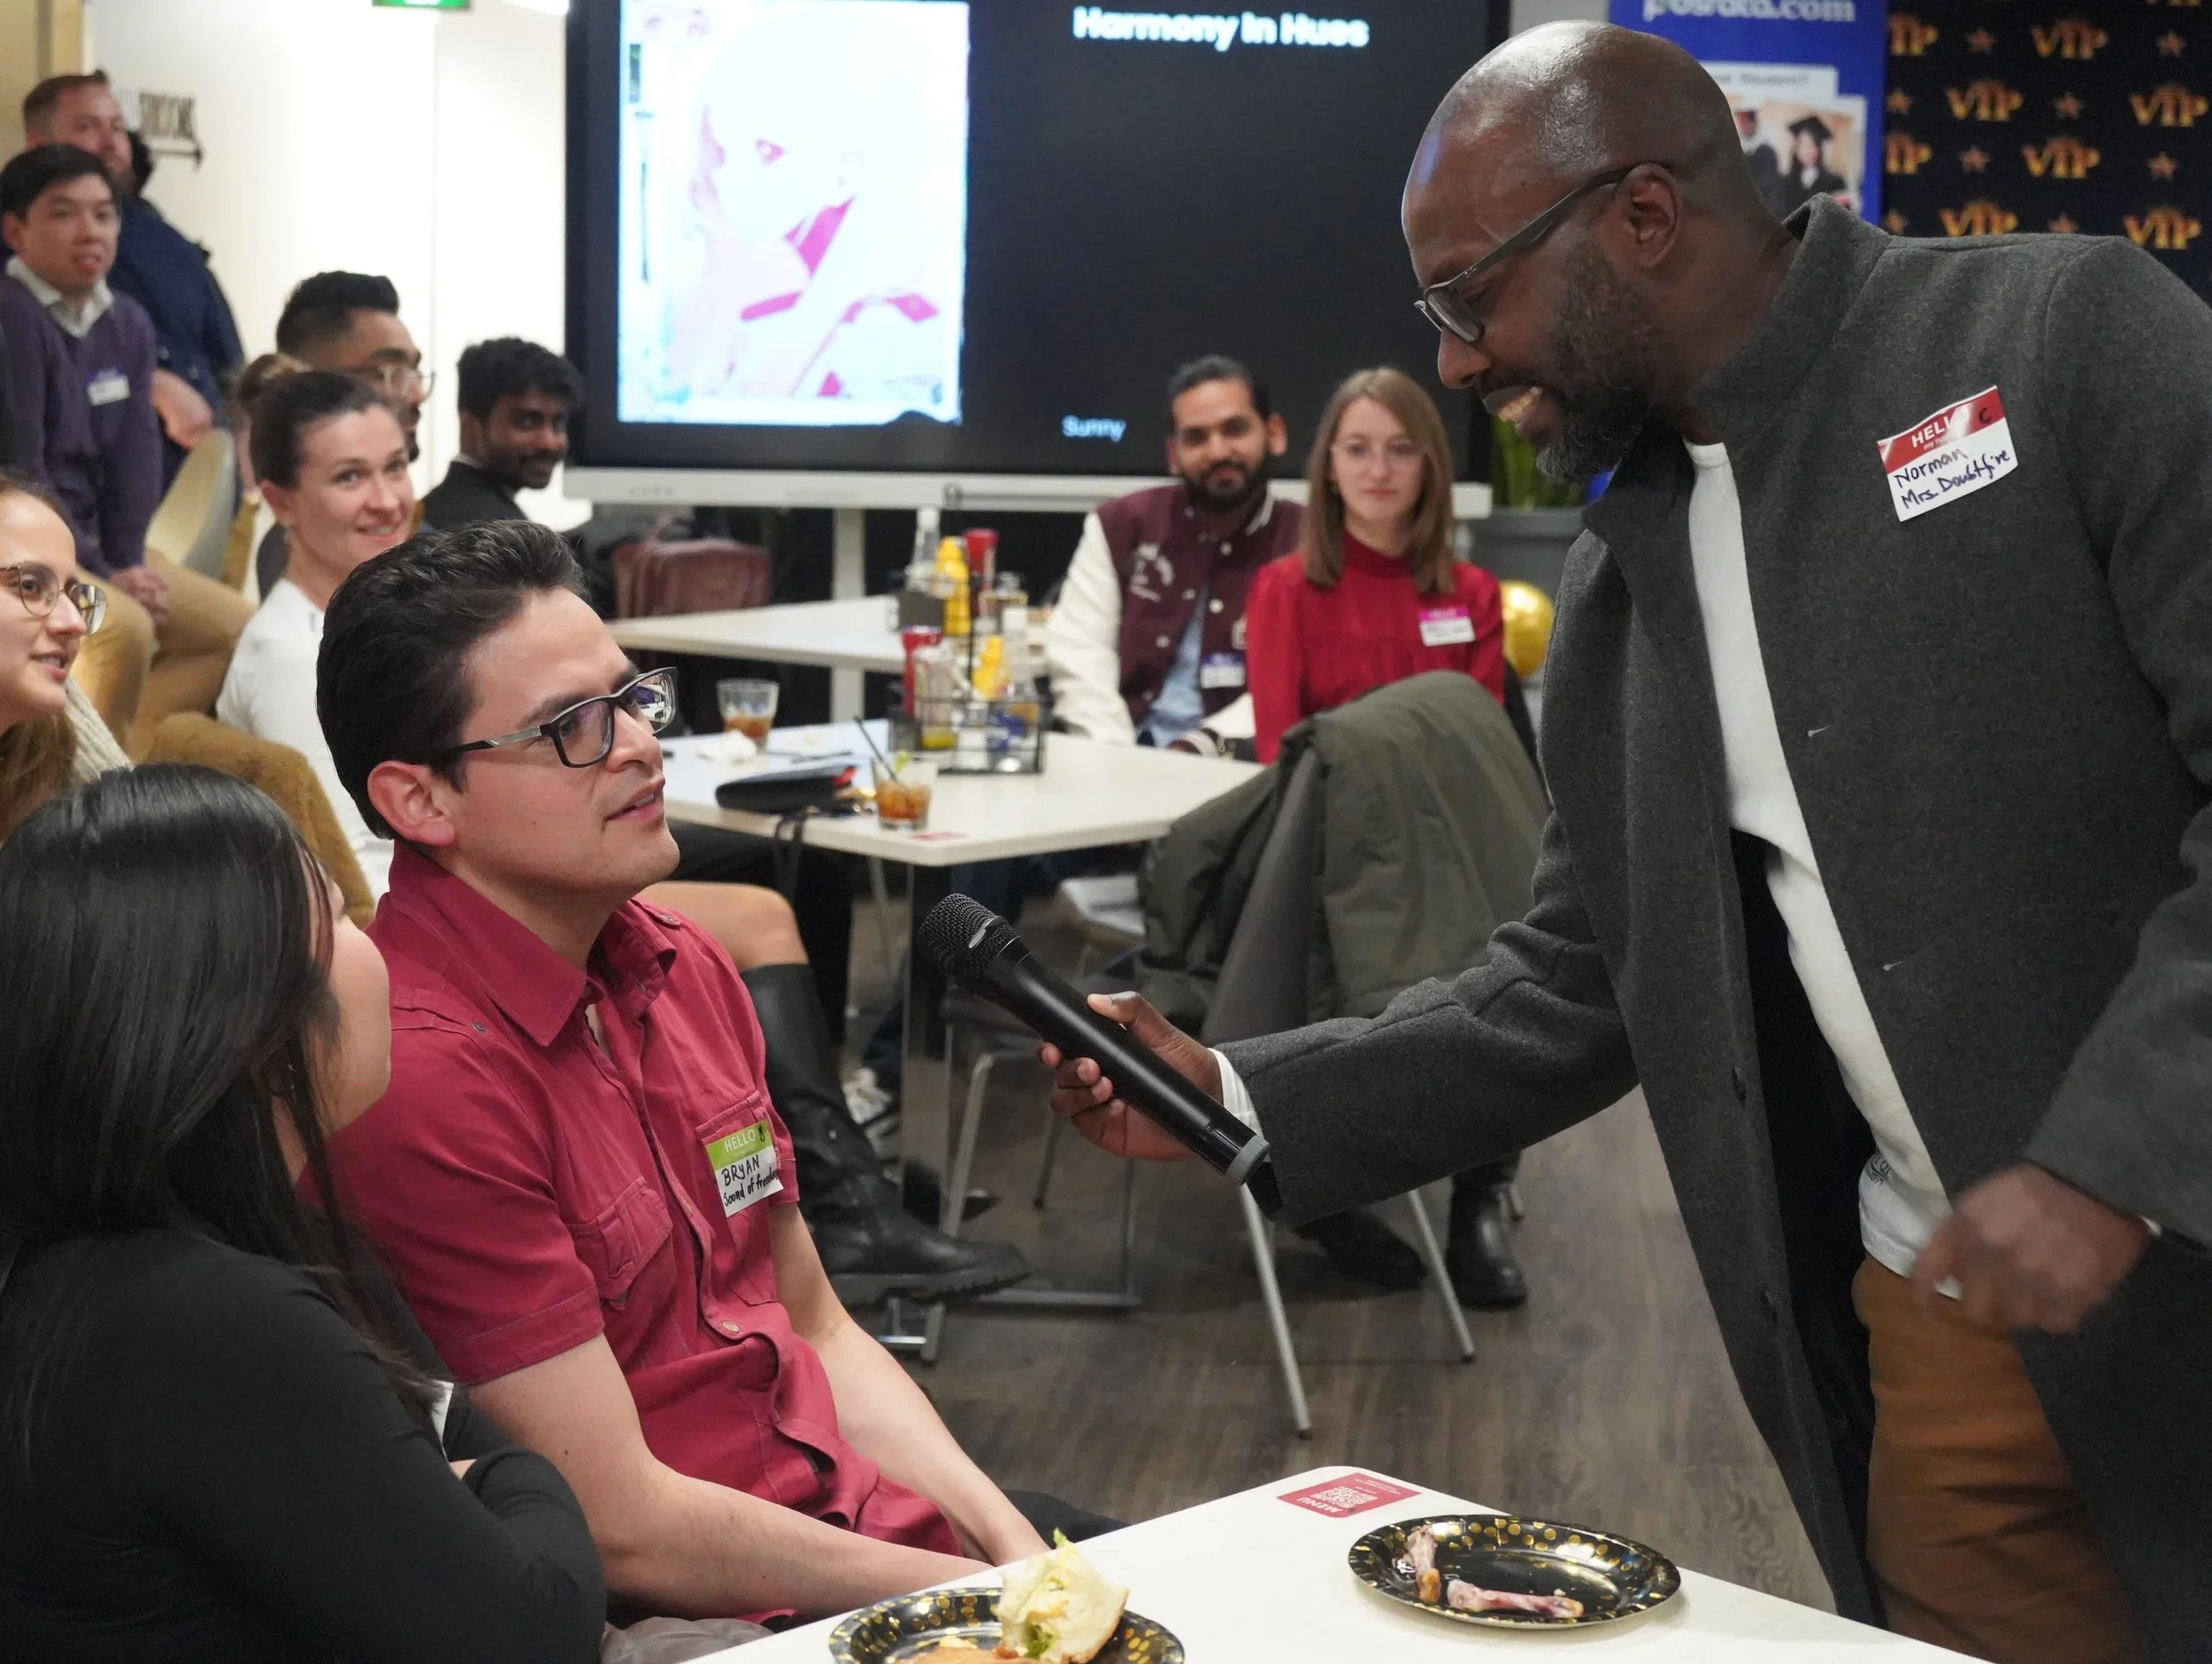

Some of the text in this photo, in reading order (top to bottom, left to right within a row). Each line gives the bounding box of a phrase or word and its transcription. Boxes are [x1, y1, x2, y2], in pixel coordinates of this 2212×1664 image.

[1073, 6, 1239, 51] Harmony
[1280, 13, 1369, 47] Hues
[1888, 14, 1939, 57] IP
[2032, 19, 2108, 58] VIP
[1947, 80, 2024, 120] VIP
[2129, 84, 2208, 127] VIP
[1886, 134, 1932, 174] IP
[2022, 136, 2101, 179] VIP
[1939, 201, 2018, 236] VIP
[2124, 207, 2201, 249] VIP
[1062, 414, 1126, 441] Sunny
[1893, 449, 1968, 487] Norman
[1937, 450, 2010, 492] Doubtfire
[724, 1129, 756, 1153] HELLO
[748, 1177, 754, 1194] of
[1296, 1497, 1342, 1514] MENU
